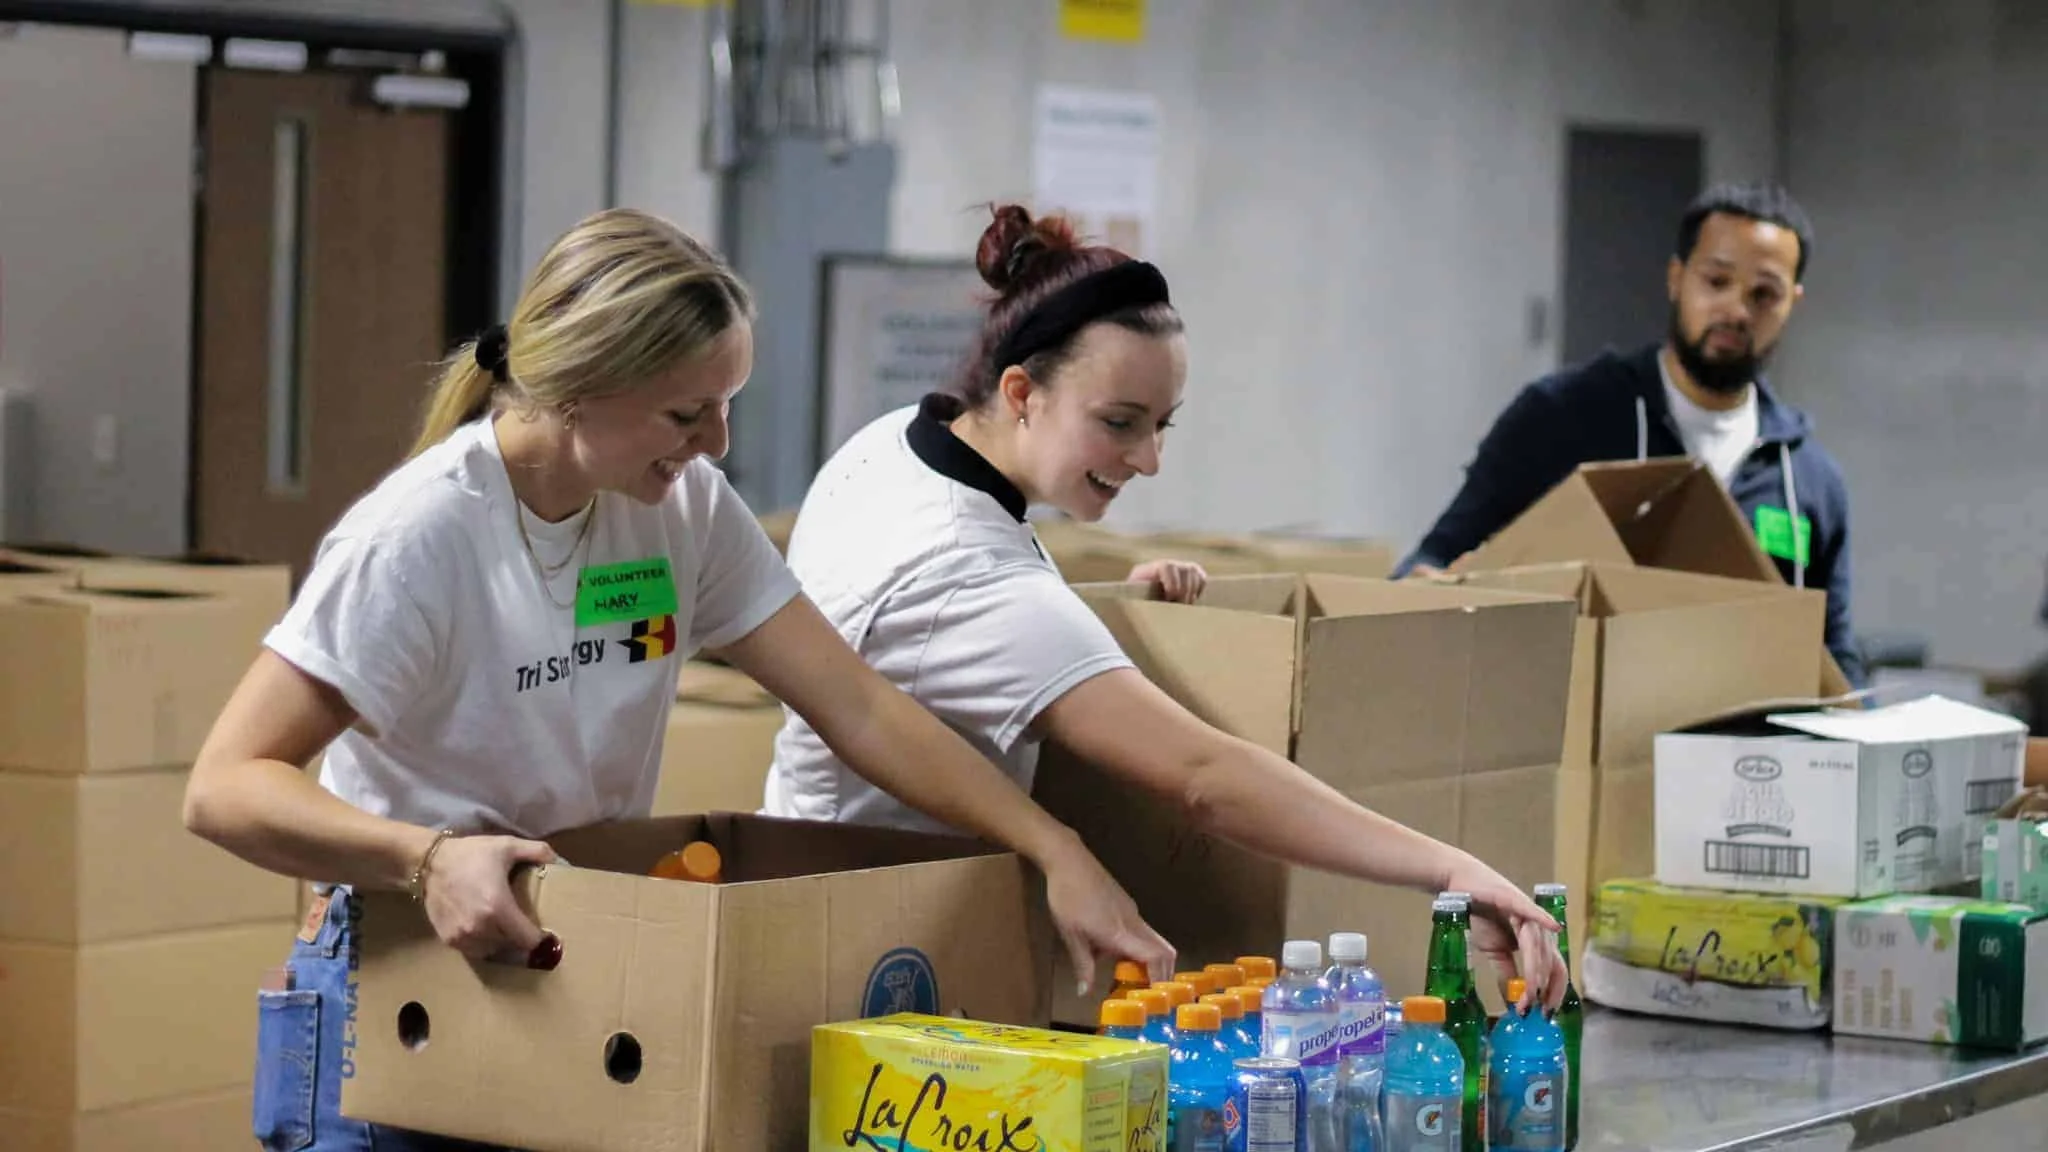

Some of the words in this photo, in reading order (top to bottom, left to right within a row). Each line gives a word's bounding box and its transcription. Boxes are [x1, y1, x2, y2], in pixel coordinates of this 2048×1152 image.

[589, 567, 666, 587] VOLUNTEER
[516, 660, 542, 692] Tri
[1338, 1009, 1375, 1038] ropel
[1300, 1024, 1340, 1057] prope
[1415, 1103, 1444, 1136] G
